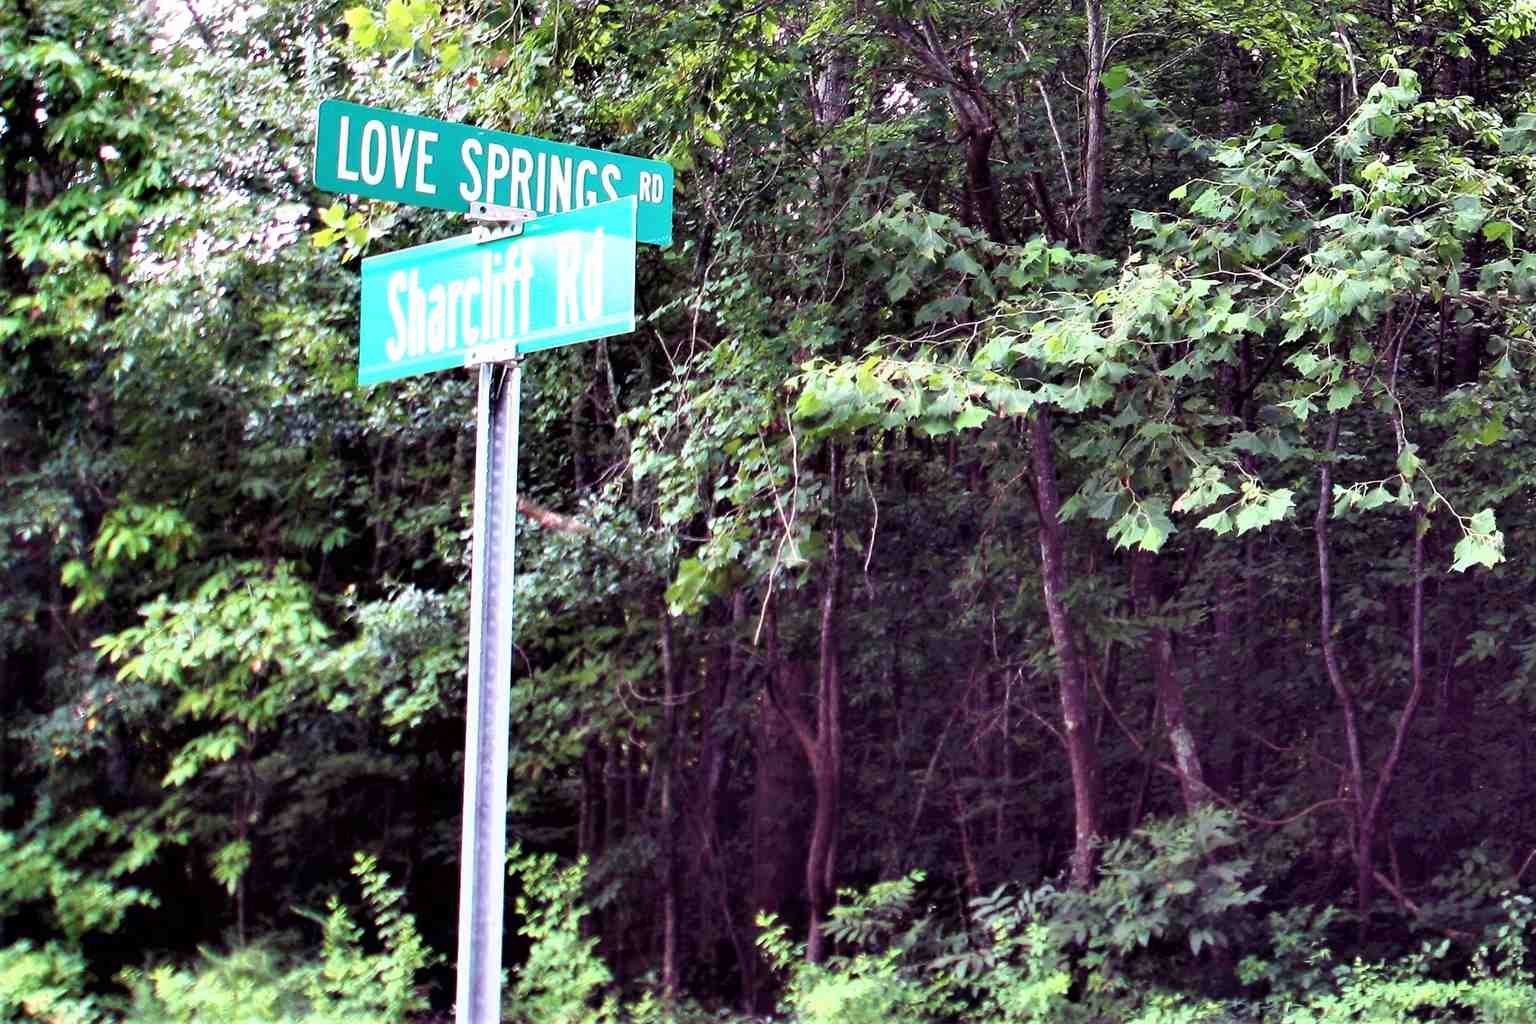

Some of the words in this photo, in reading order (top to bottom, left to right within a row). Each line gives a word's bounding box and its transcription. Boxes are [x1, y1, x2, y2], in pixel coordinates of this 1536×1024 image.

[336, 115, 439, 195] LOVE
[459, 137, 622, 213] SPRINGS
[638, 170, 665, 205] RD
[556, 225, 606, 329] Rd
